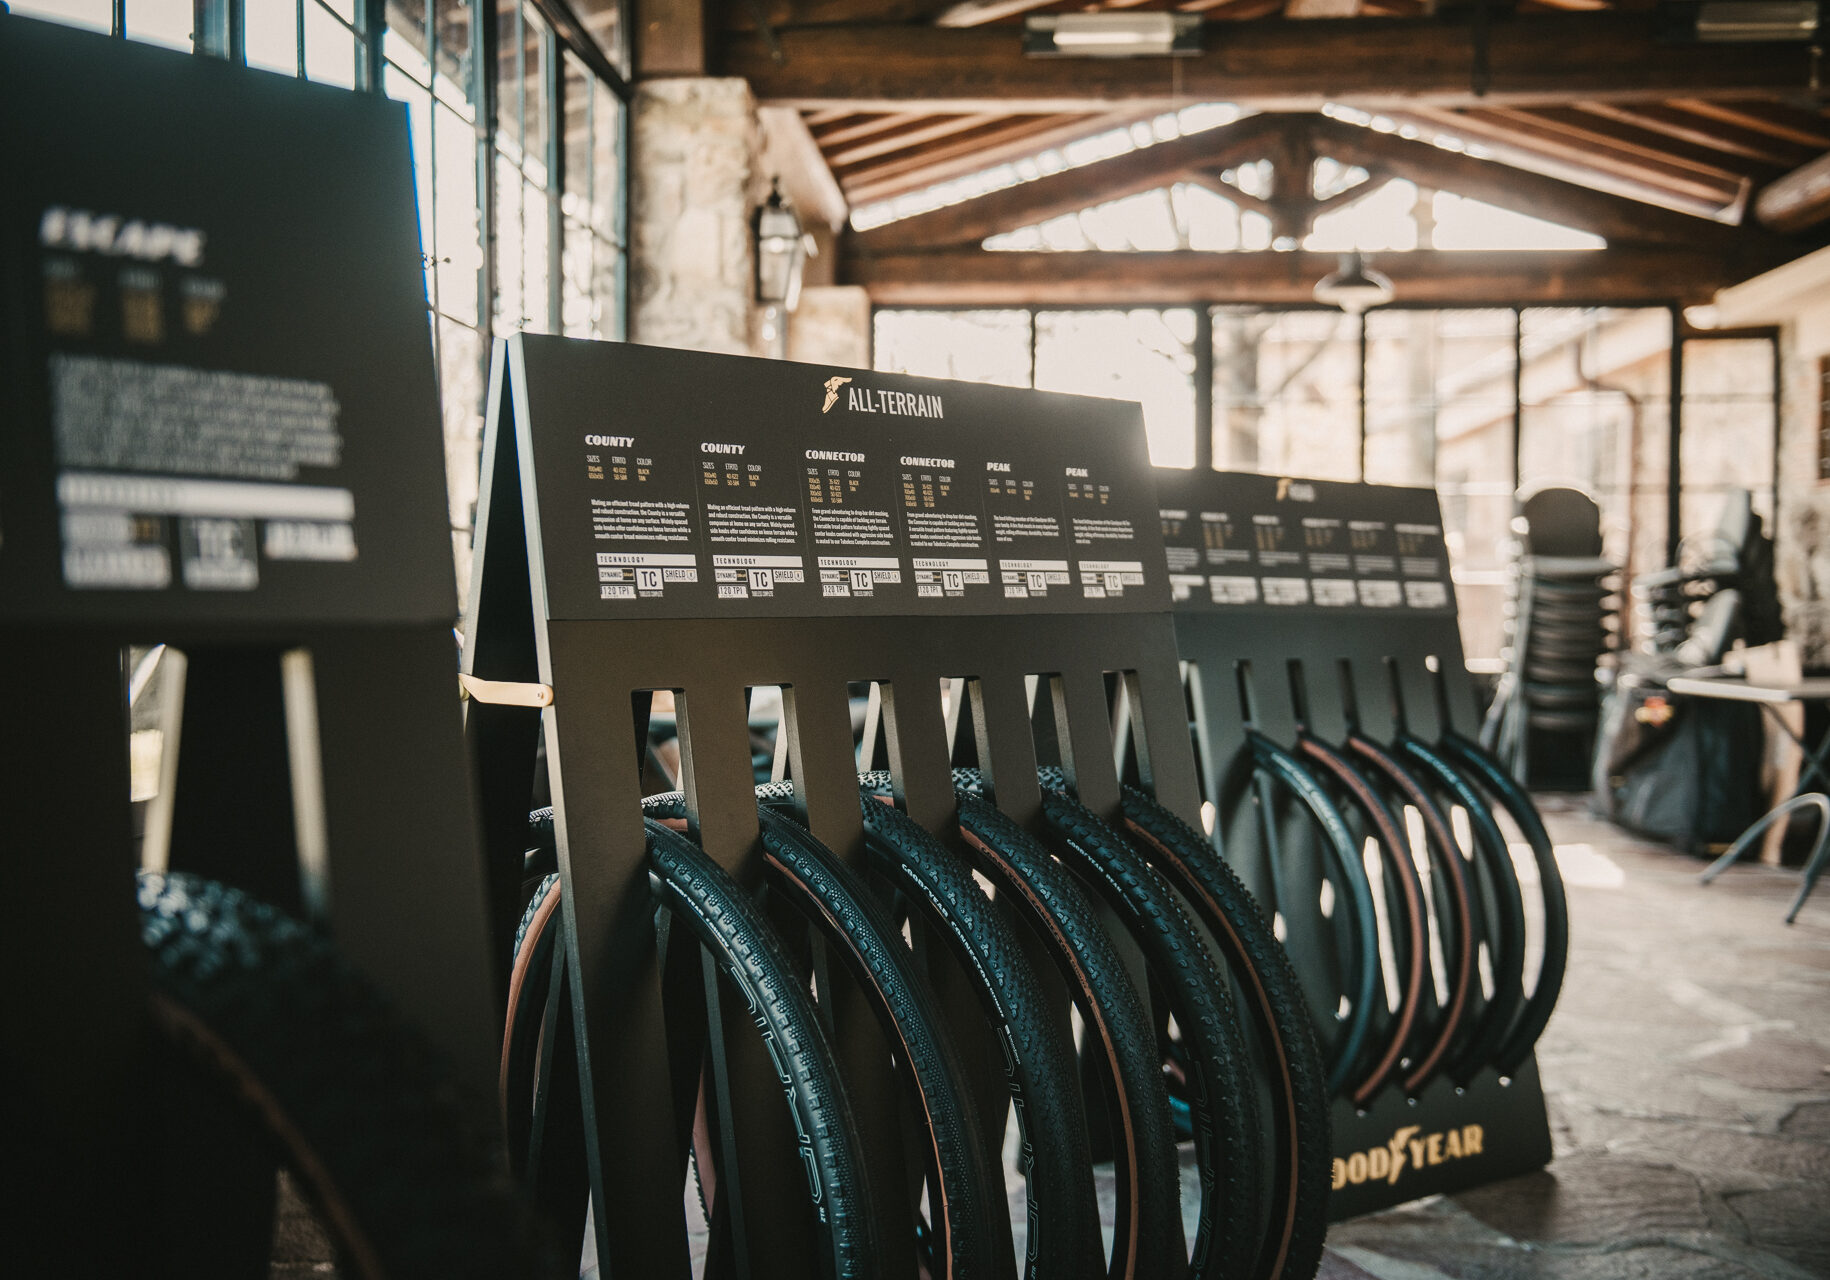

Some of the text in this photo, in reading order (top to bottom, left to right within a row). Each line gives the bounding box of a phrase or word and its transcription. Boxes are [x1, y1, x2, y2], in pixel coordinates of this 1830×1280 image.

[847, 386, 943, 419] ALL-TERRAIN
[585, 434, 635, 448] COUNTY
[701, 442, 746, 455] COUNTY
[805, 449, 865, 463] CONNECTOR
[900, 456, 955, 469] CONNECTOR
[986, 462, 1011, 472] PEAK
[1065, 467, 1088, 477] PEAK
[641, 571, 657, 587] TC
[665, 570, 686, 578] SHIELD
[754, 572, 768, 587] TC
[855, 573, 868, 587] TC
[947, 574, 959, 588] TC
[1031, 574, 1042, 588] TC
[603, 586, 617, 595] 120
[618, 586, 630, 595] TPI
[719, 586, 732, 594] 120
[733, 586, 743, 594] TPI
[1066, 838, 1122, 893] GOODYEAR PEAK
[901, 863, 949, 918] GOODYEAR
[951, 920, 990, 987] CONNECTOR
[1331, 1123, 1483, 1191] OODYEAR
